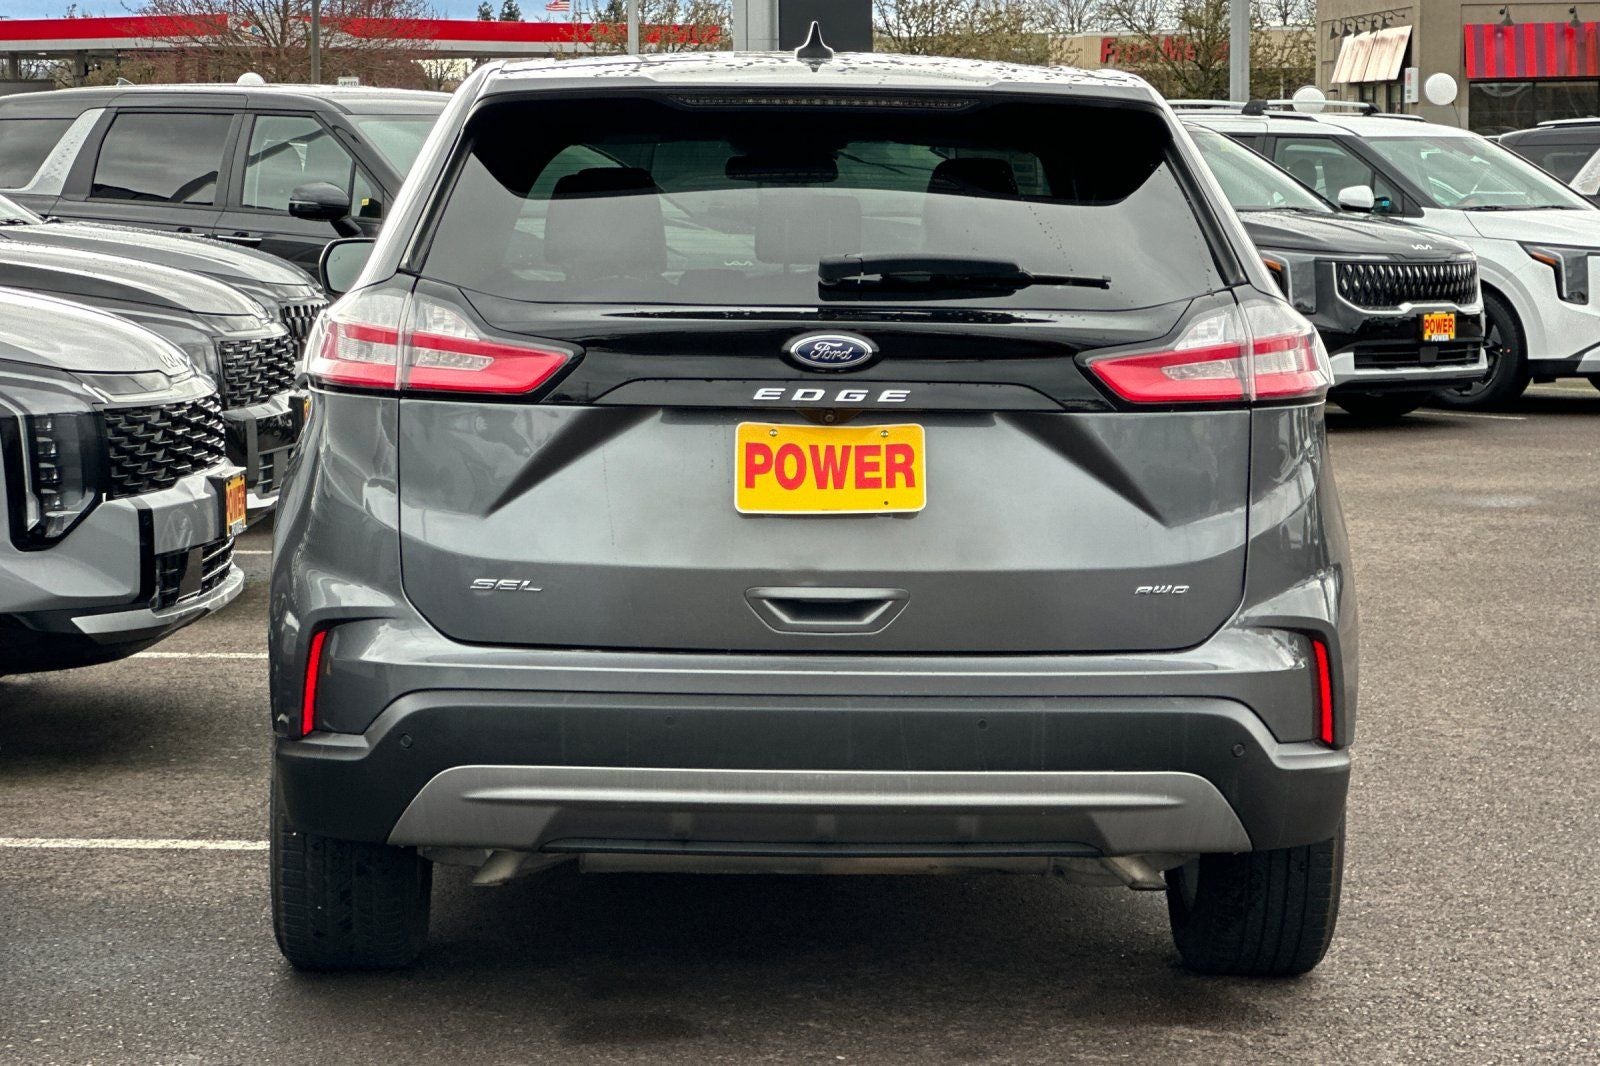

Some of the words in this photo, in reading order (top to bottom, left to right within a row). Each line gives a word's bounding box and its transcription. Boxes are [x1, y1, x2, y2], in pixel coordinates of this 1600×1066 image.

[1424, 318, 1454, 334] POWER
[810, 341, 853, 360] Ford
[753, 387, 911, 403] EDGE
[744, 442, 916, 491] POWER
[470, 578, 543, 592] SEL
[1134, 584, 1190, 595] AWD
